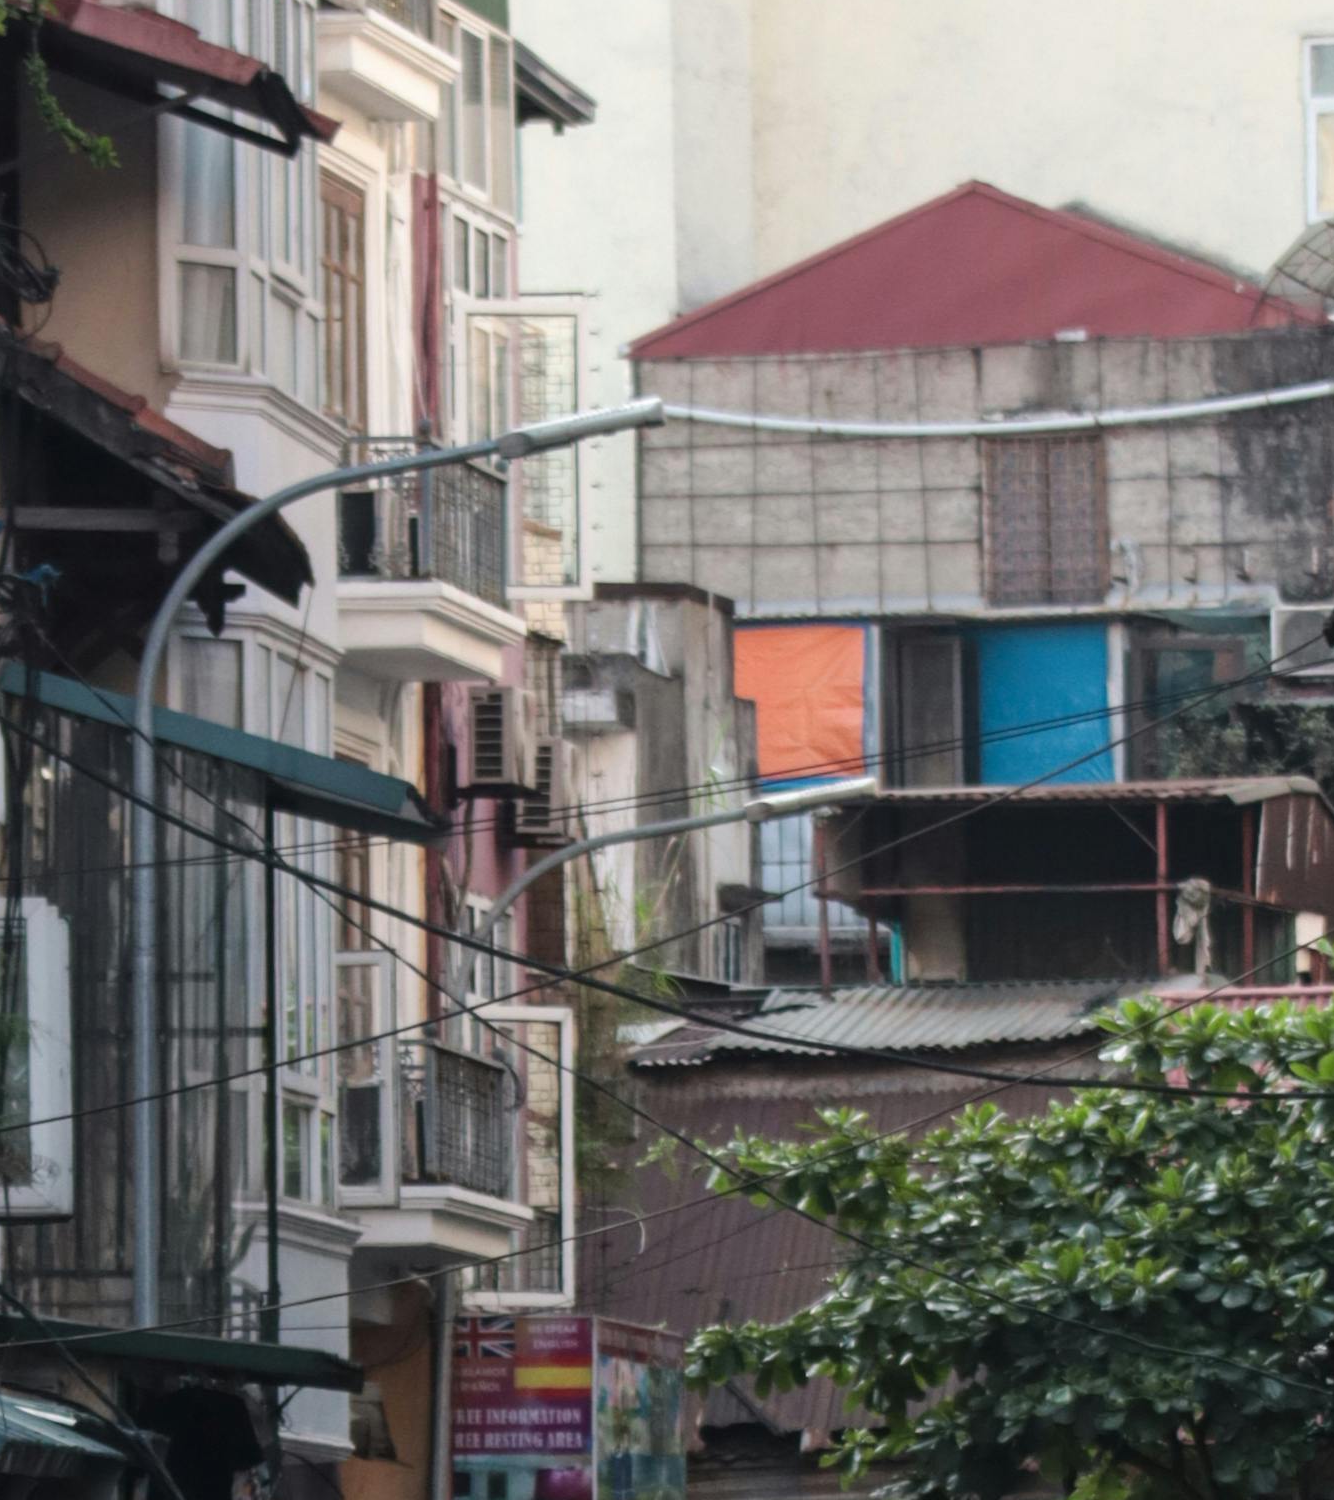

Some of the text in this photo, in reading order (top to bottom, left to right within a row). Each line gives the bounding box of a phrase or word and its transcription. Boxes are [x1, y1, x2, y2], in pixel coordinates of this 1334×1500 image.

[487, 1407, 582, 1425] INFORMATION
[485, 1431, 544, 1449] RESTING
[546, 1431, 583, 1449] AREA
